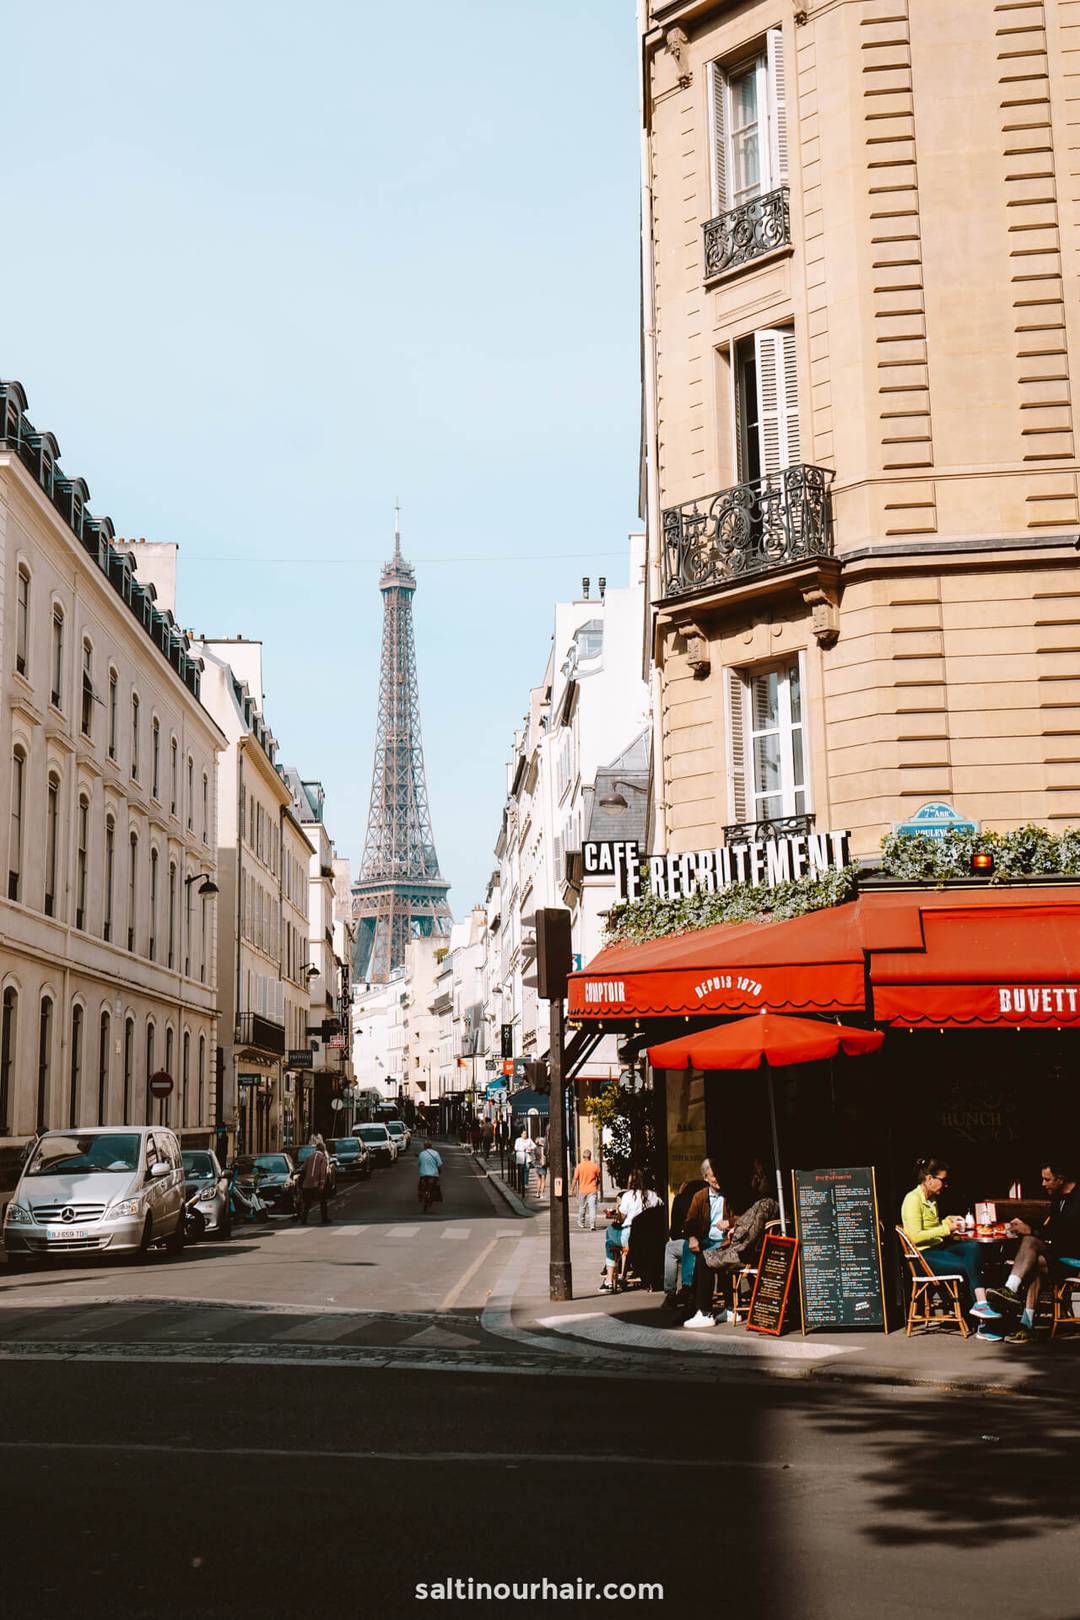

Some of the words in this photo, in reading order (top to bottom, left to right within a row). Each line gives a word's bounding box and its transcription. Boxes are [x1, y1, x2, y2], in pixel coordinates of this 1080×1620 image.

[915, 828, 958, 837] OULEVAD
[584, 842, 637, 872] CAFE
[613, 857, 641, 905] LE
[649, 830, 849, 901] RECRUTEMENT
[585, 981, 626, 1003] COMPTOIR
[694, 975, 733, 999] DEPUIS
[736, 976, 763, 997] 1870
[999, 988, 1080, 1012] BUVETT
